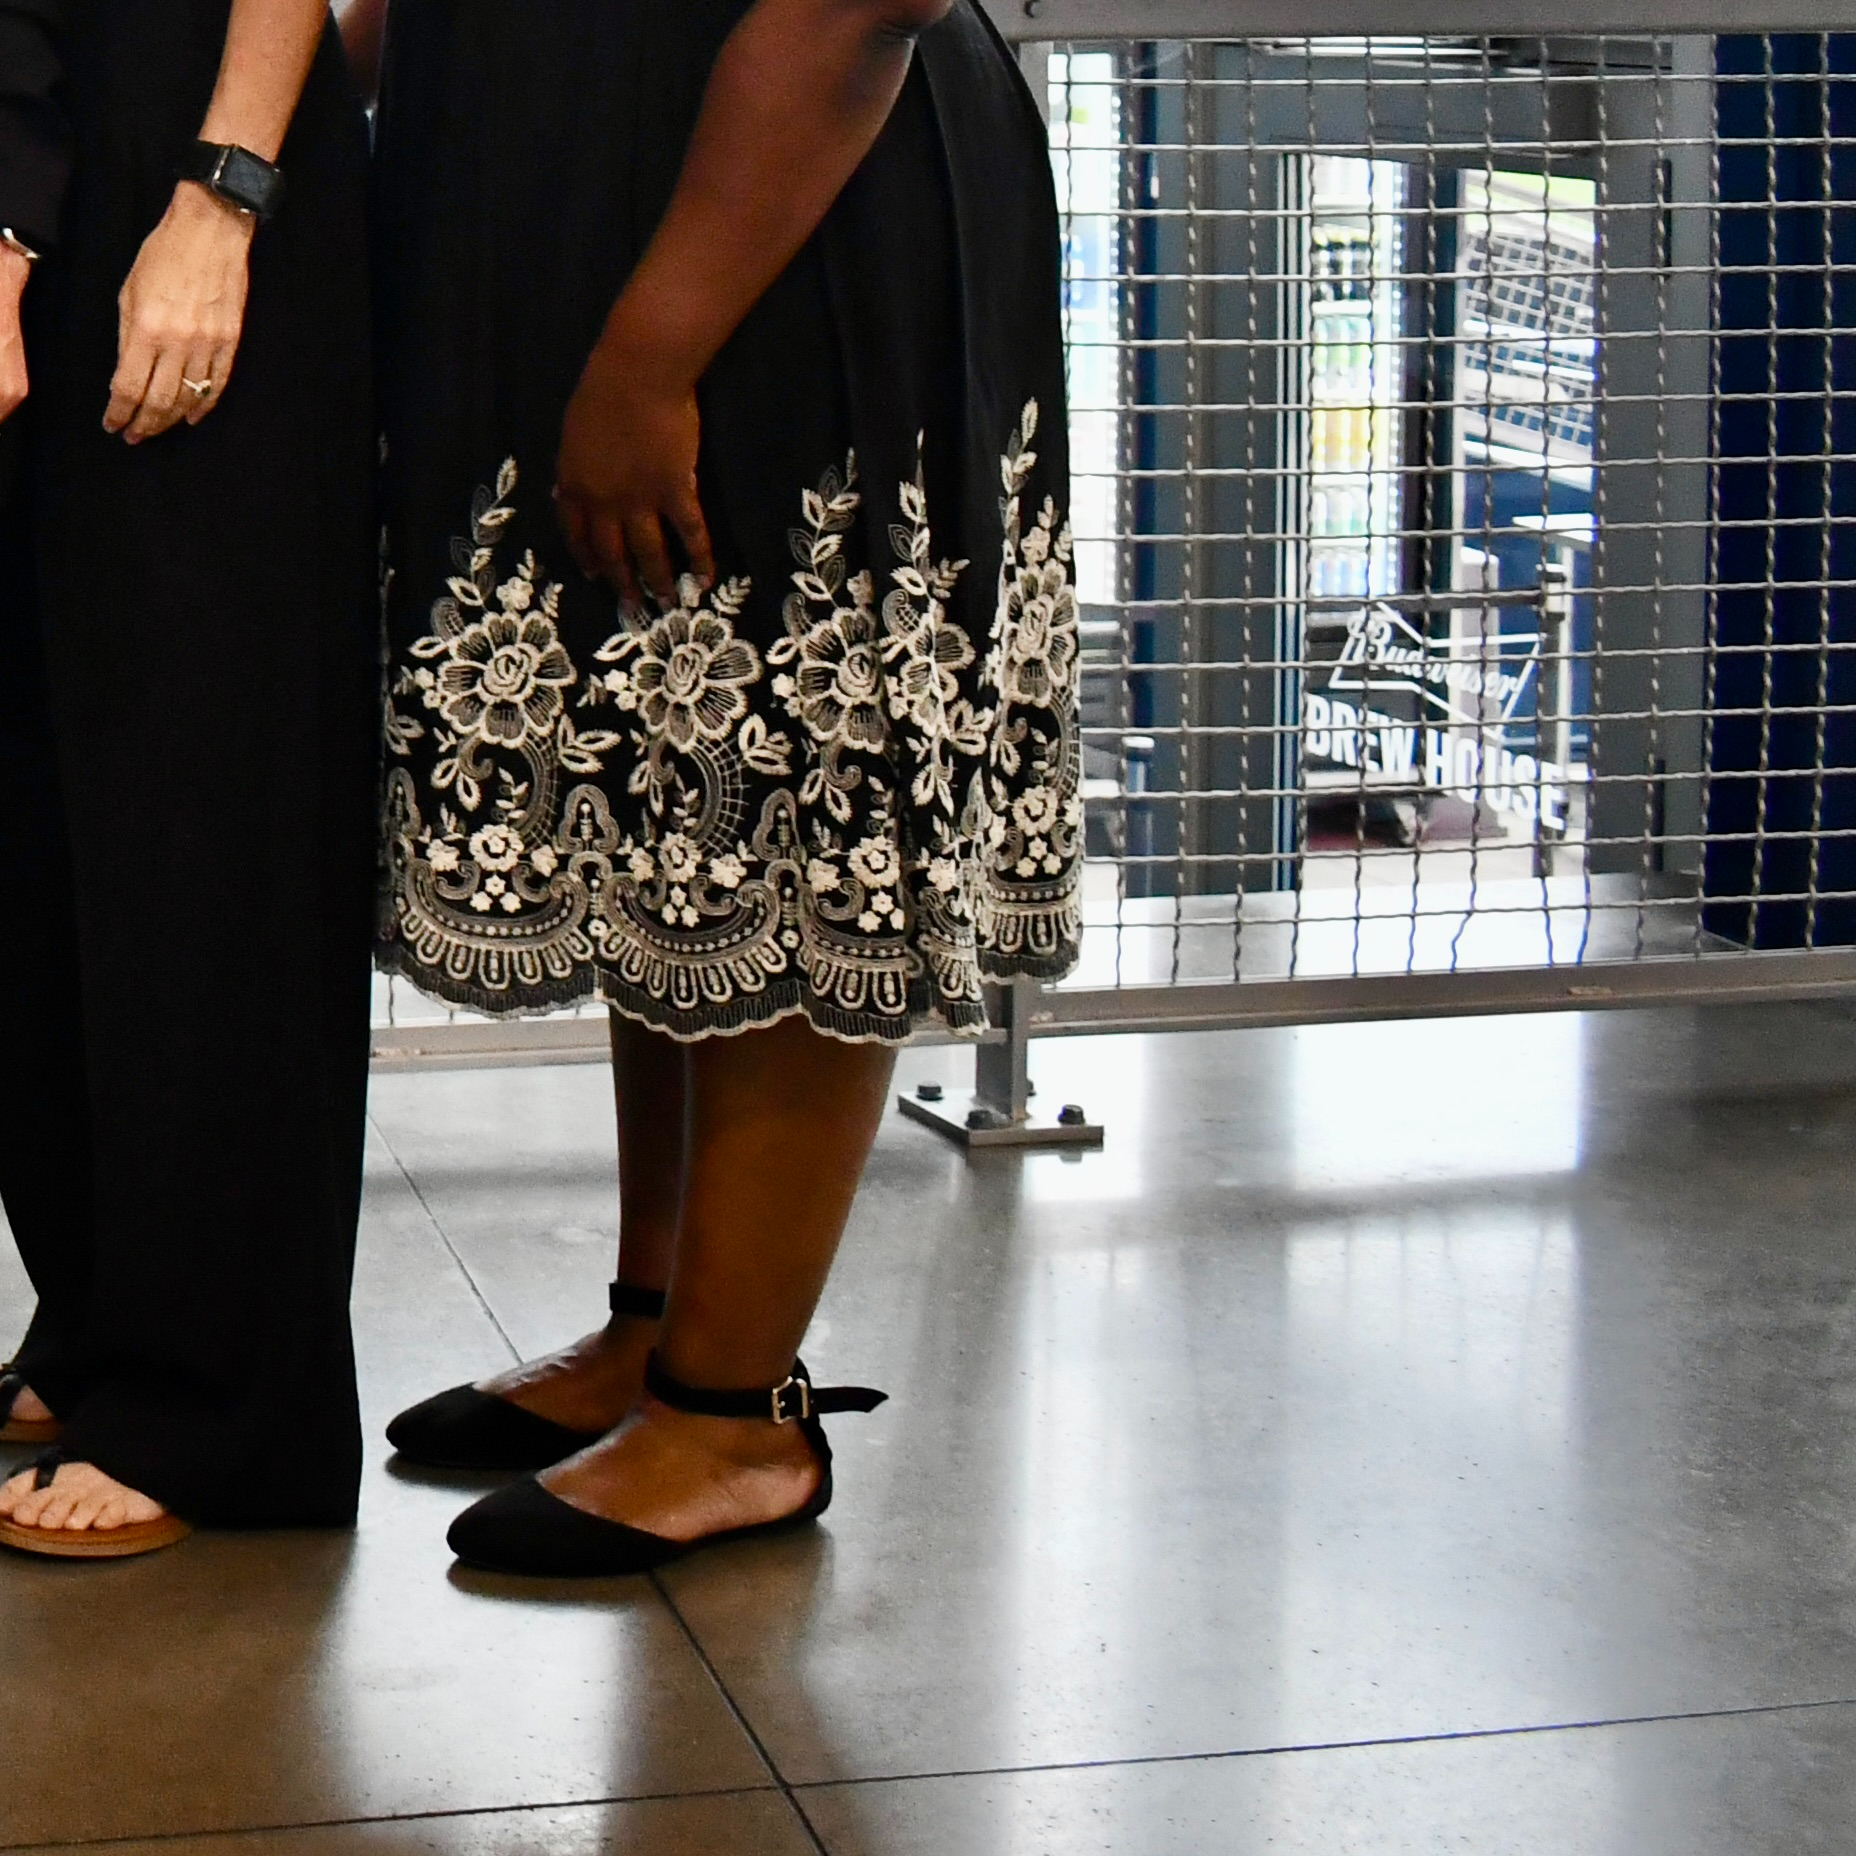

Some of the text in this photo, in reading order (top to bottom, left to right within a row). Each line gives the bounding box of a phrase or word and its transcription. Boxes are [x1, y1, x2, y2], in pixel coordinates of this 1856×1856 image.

[1346, 612, 1518, 700] Budweiser
[1305, 692, 1566, 831] BREW HOUSE
